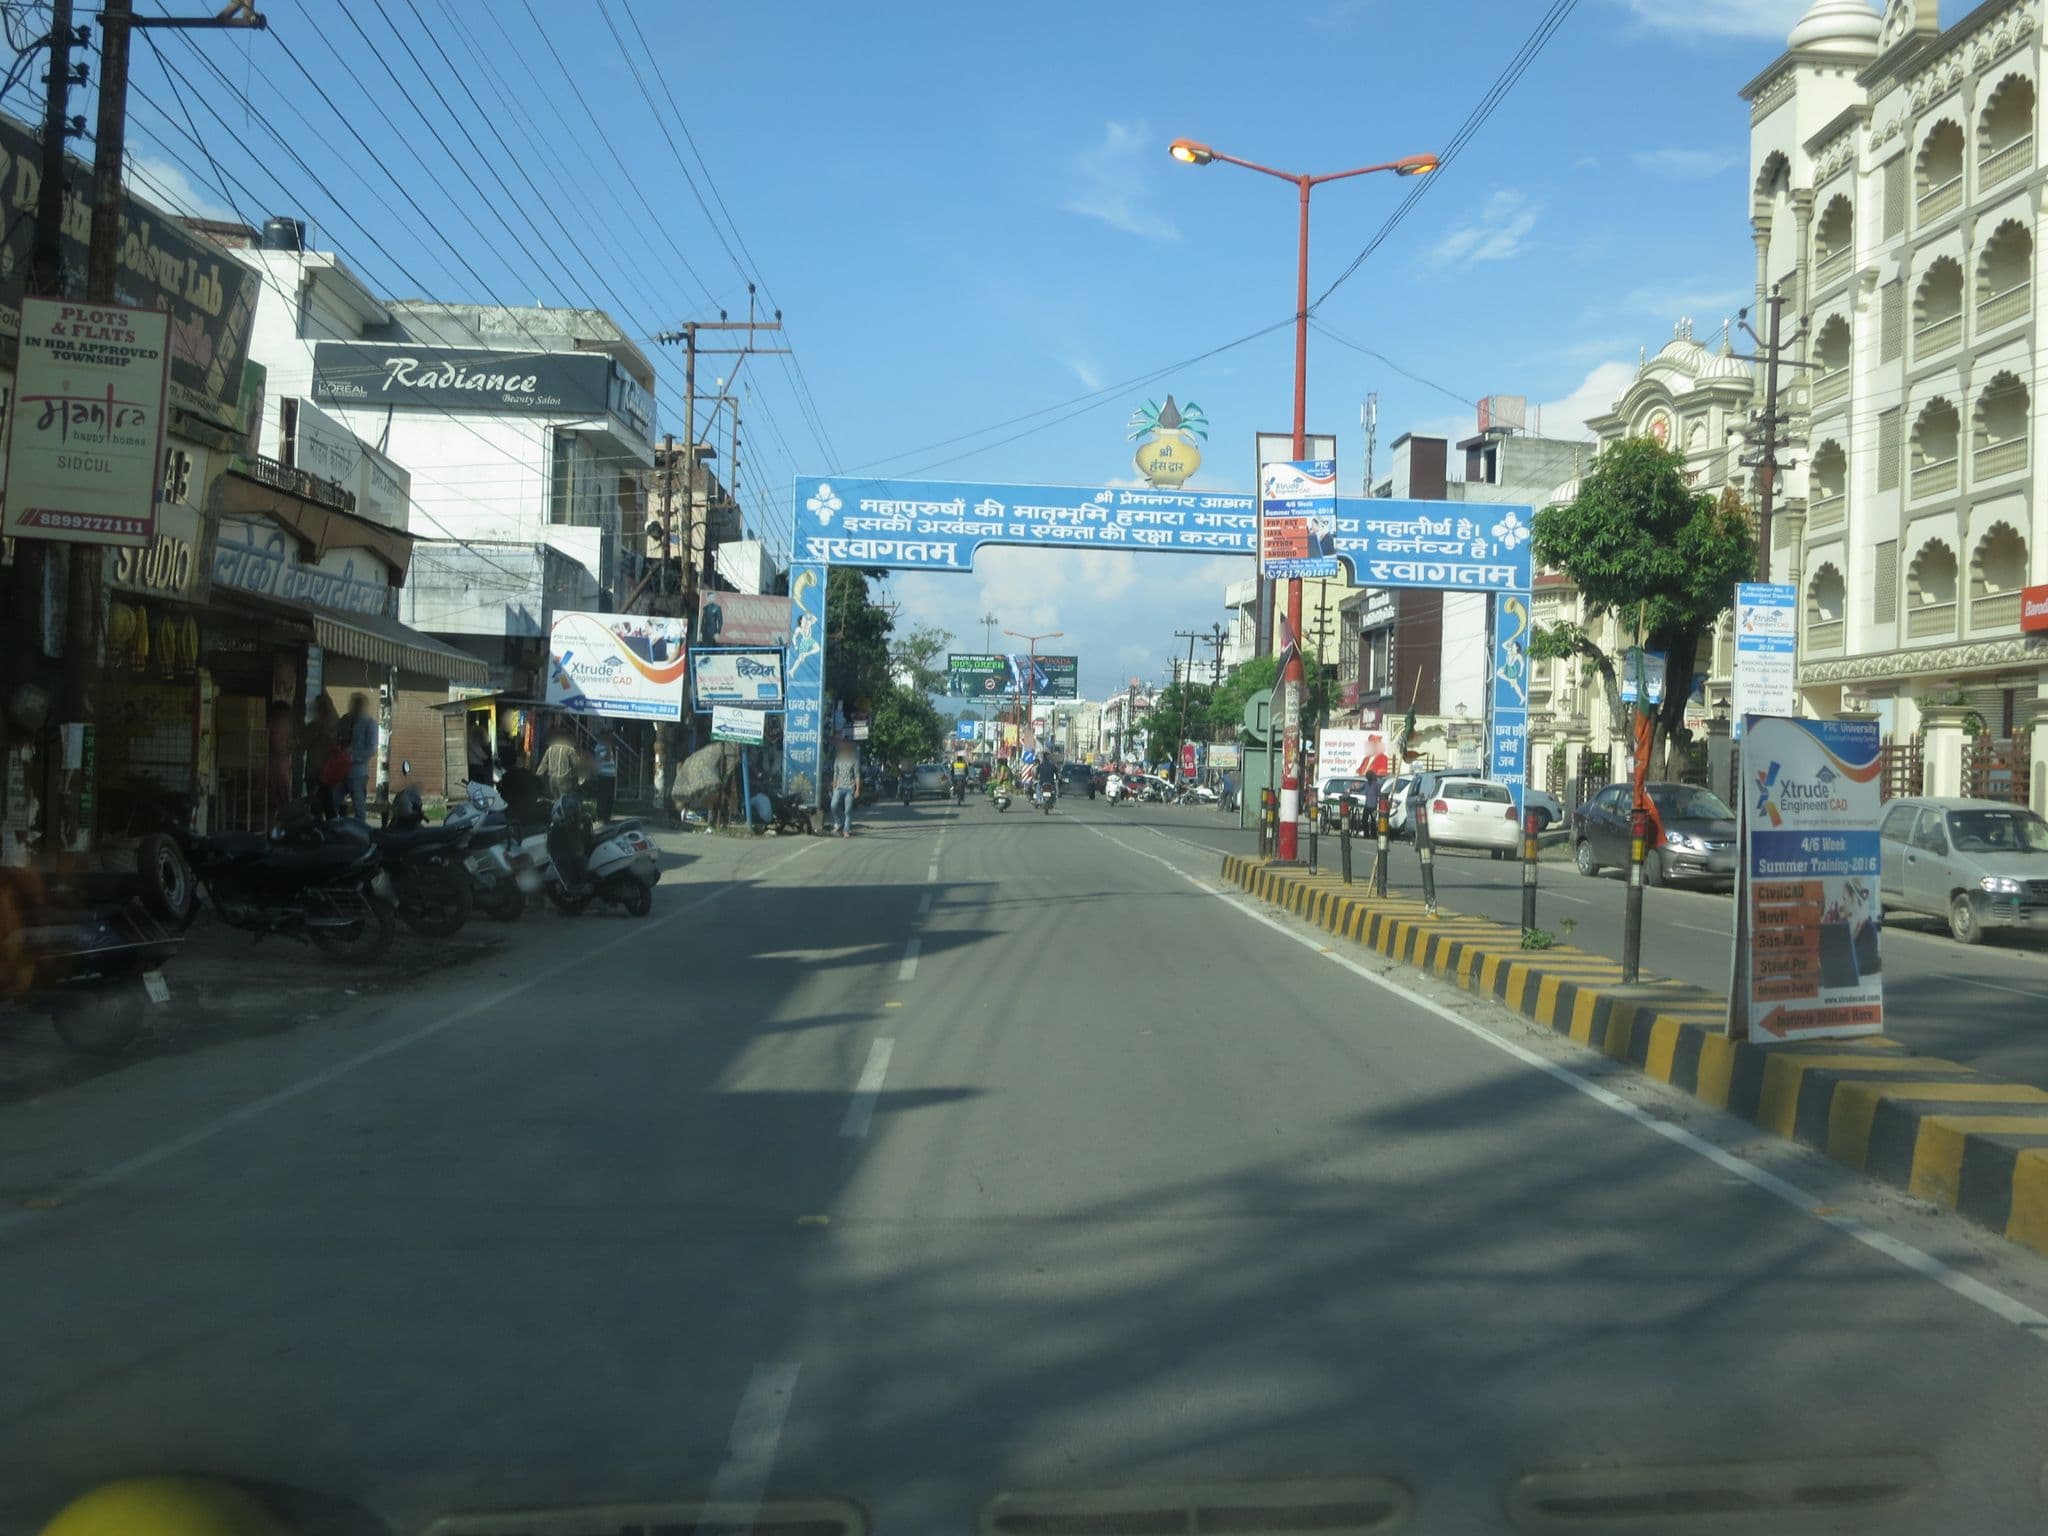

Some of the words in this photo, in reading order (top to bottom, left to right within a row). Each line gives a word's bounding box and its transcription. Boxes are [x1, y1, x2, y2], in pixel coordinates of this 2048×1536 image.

[184, 257, 223, 317] Lab
[61, 307, 129, 327] PLOTS
[51, 323, 67, 336] &
[72, 324, 135, 343] FLATS
[24, 336, 41, 347] IN
[44, 338, 75, 351] HDA
[79, 342, 159, 360] APPROVED
[53, 350, 131, 367] TOWNSHIP
[381, 357, 536, 393] Radiance
[502, 393, 534, 407] Beauty
[535, 395, 561, 406] Salon
[73, 431, 104, 444] happy
[112, 435, 146, 446] homes
[57, 456, 113, 473] SIDCUL
[1094, 489, 1113, 504] श्री
[1120, 493, 1197, 508] प्रेमनगर
[1200, 497, 1253, 510] आश्रम
[40, 513, 145, 534] 8899777111
[860, 498, 965, 518] महापुरुषों
[975, 498, 1005, 518] की
[1013, 503, 1109, 527] मातृभूमि
[1117, 509, 1185, 527] हमारा
[1193, 512, 1256, 528] भारत
[1367, 516, 1452, 538] महातीर्थ
[843, 514, 911, 532] इसकी
[918, 518, 1004, 536] अखंडता
[1009, 523, 1025, 536] व
[1099, 522, 1125, 541] की
[1132, 528, 1173, 546] रक्षा
[1180, 530, 1240, 546] करना
[805, 536, 959, 567] सुस्वागतम्
[1268, 550, 1297, 558] ANDROID
[1370, 559, 1518, 589] स्वागतम्
[571, 662, 613, 677] Xtrude
[613, 676, 633, 686] CAD
[1840, 722, 1877, 735] University
[1780, 778, 1829, 799] Xtrude
[1830, 800, 1848, 812] CAD
[1801, 837, 1820, 852] 4/6
[1822, 837, 1846, 851] Week
[1759, 860, 1808, 874] Summer
